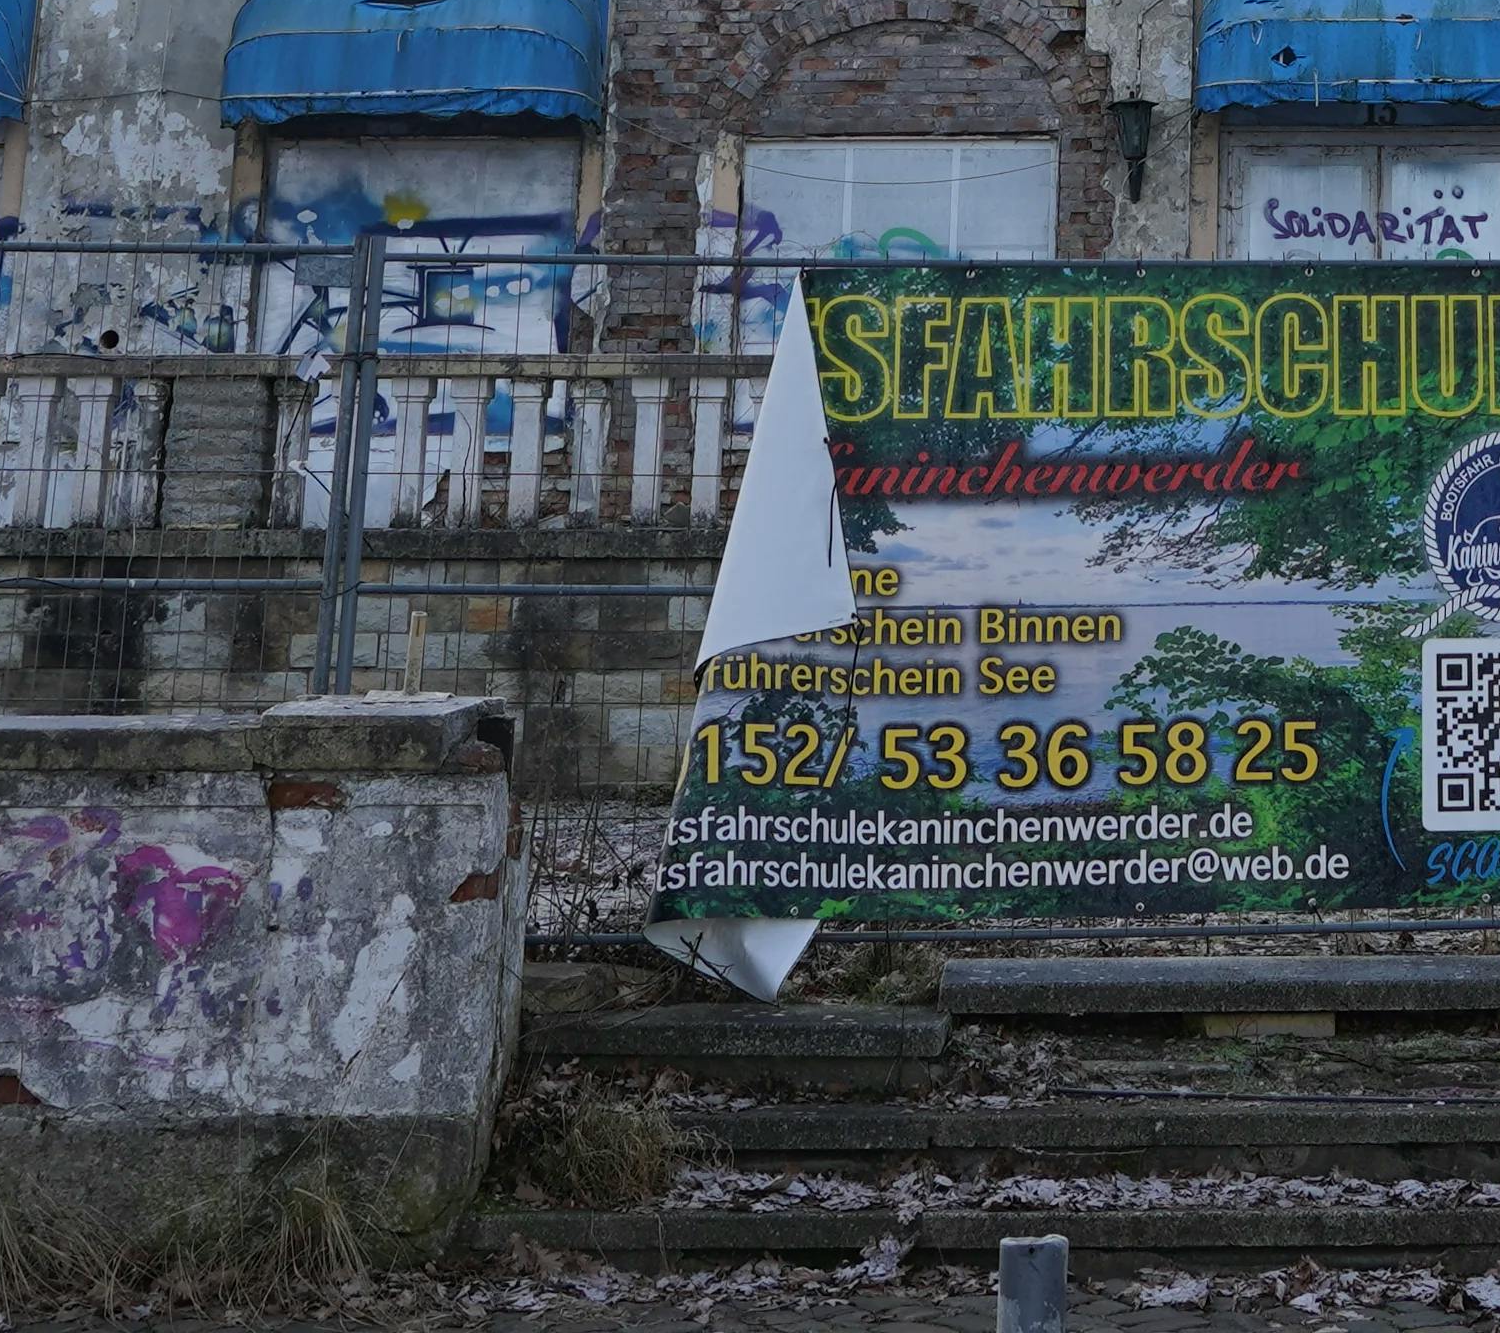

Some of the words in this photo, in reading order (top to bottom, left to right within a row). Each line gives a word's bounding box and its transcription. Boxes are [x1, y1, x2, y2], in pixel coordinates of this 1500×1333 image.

[1440, 453, 1495, 522] BOOTSFAHR
[980, 607, 1122, 644] Binnen
[979, 656, 1057, 695] See
[677, 723, 855, 789] 152/
[880, 726, 968, 790] 53
[999, 724, 1089, 788] 36
[1118, 721, 1208, 786] 58
[1235, 720, 1319, 782] 25
